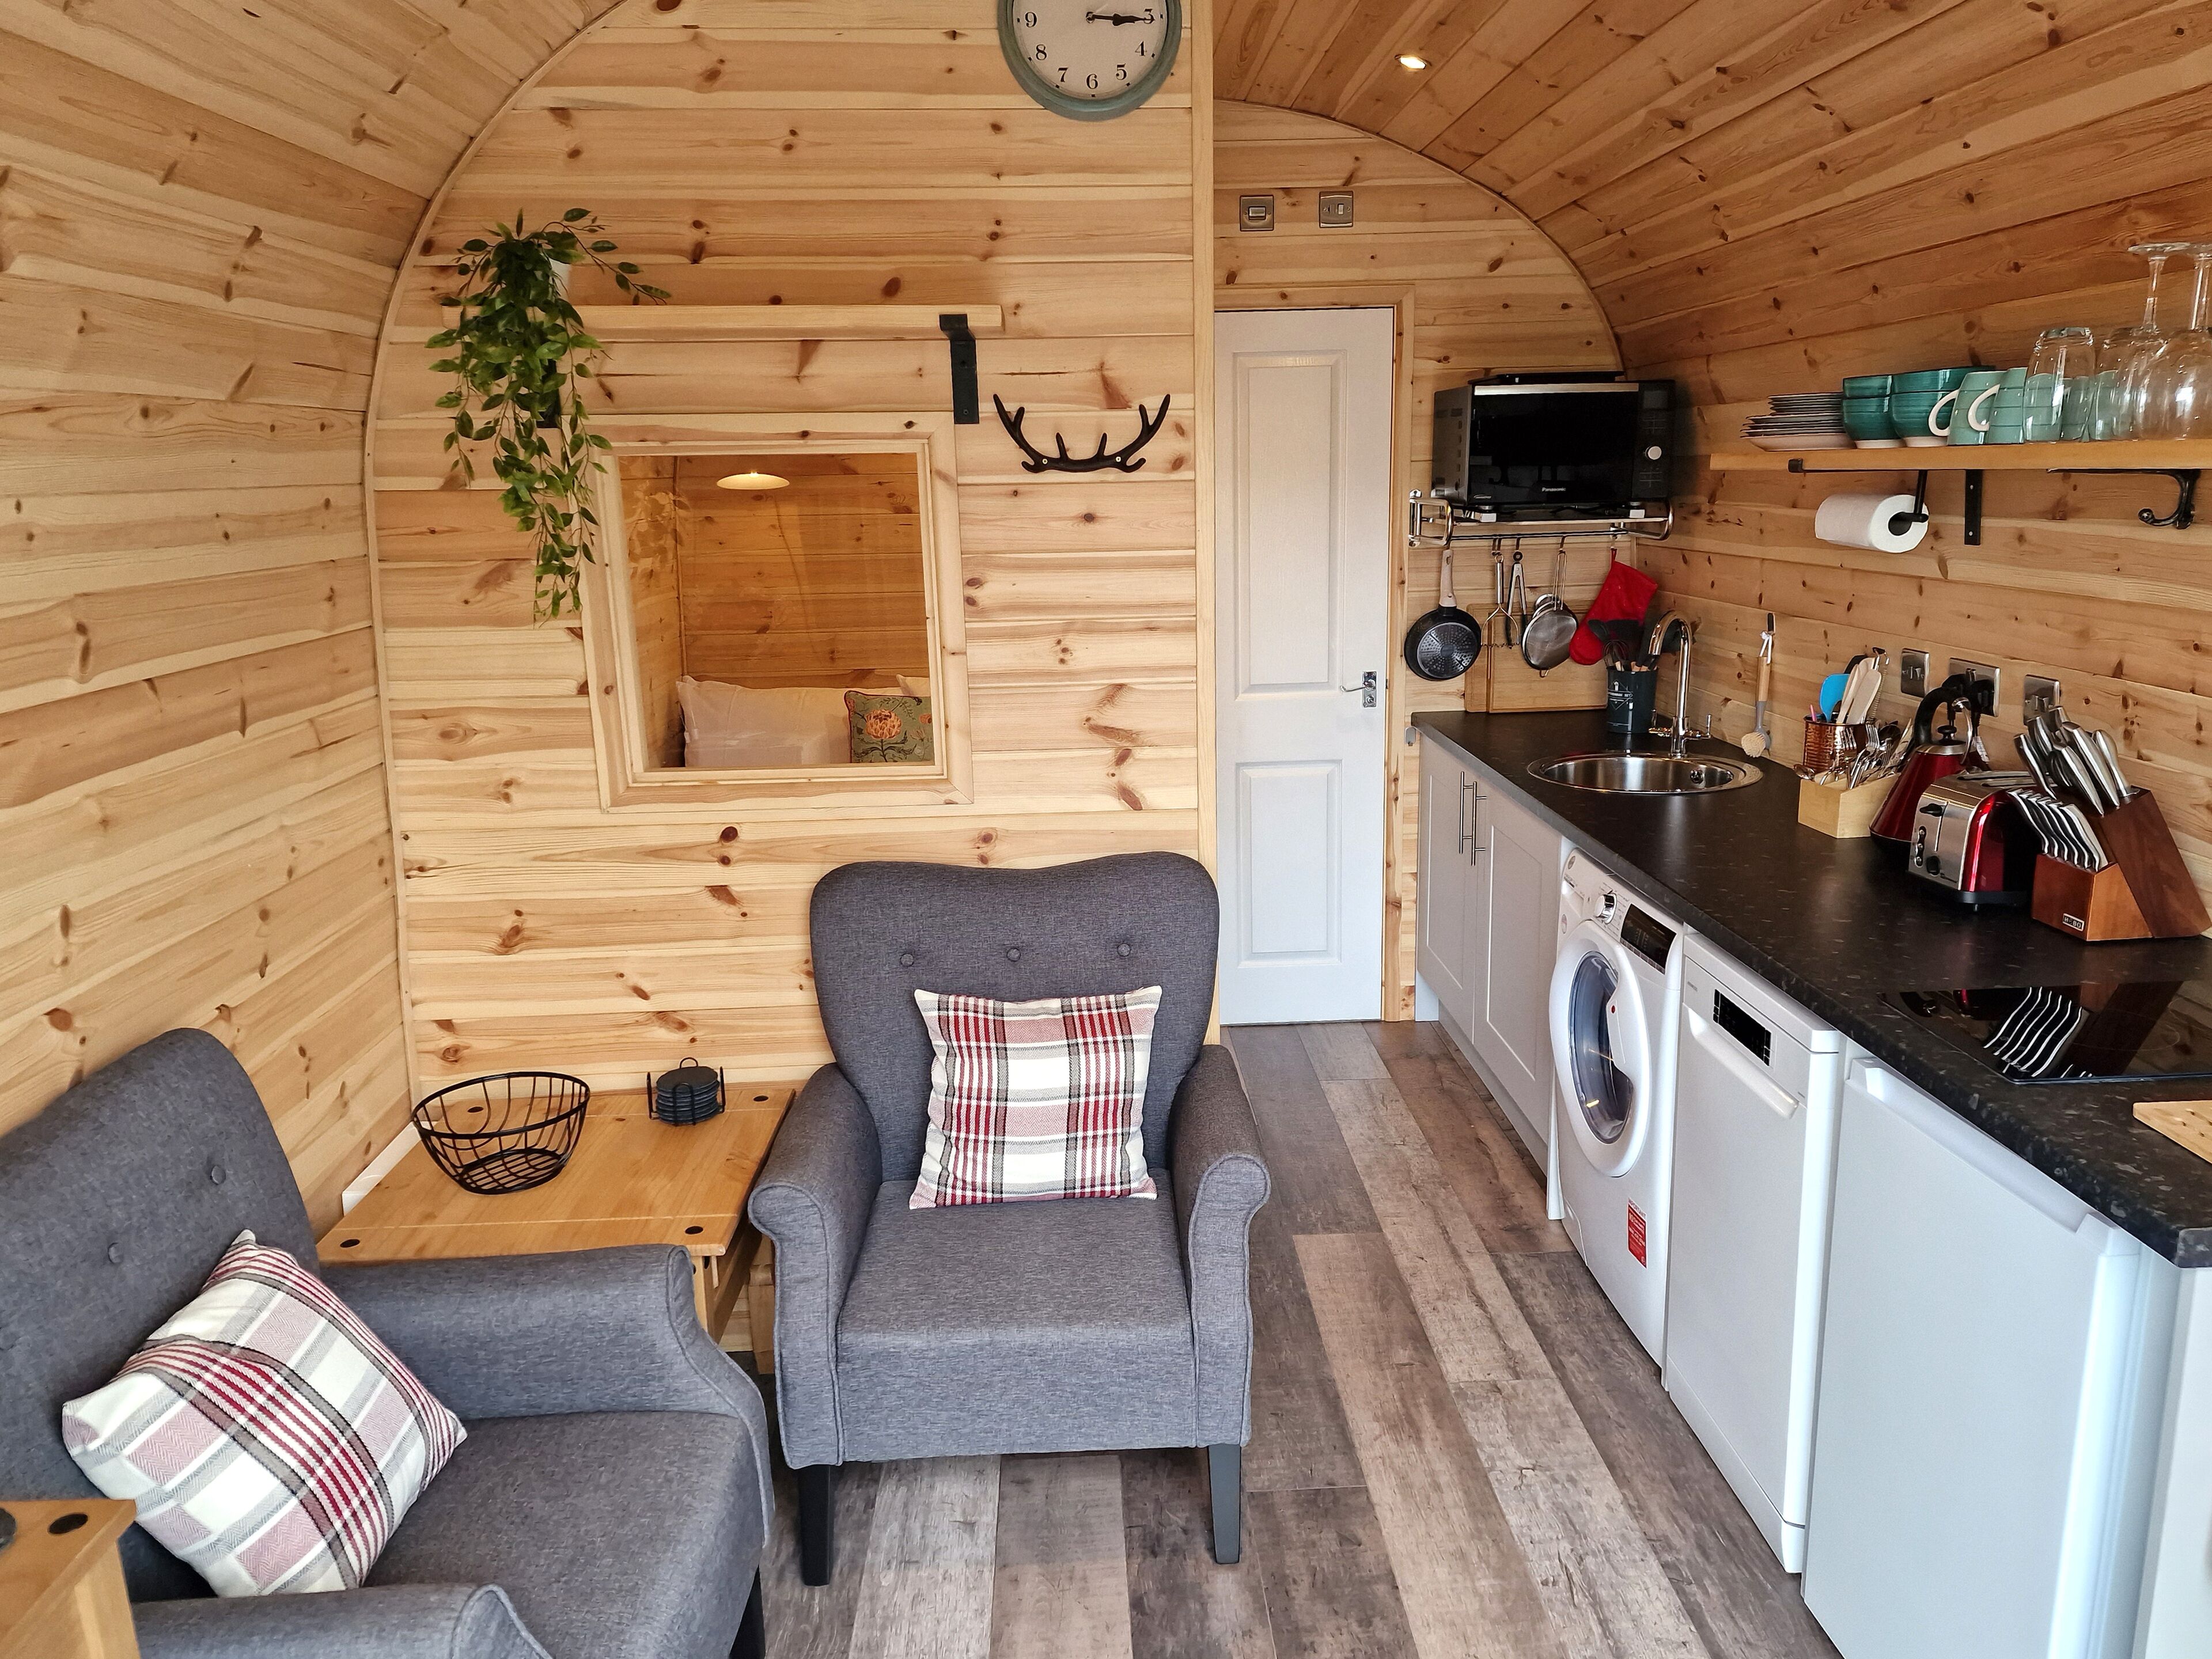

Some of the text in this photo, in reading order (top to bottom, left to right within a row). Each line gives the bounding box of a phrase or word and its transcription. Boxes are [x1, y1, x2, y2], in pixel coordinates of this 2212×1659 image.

[1025, 12, 1037, 27] 9
[1143, 9, 1154, 24] 3
[1036, 44, 1047, 60] 8
[1135, 41, 1147, 56] 4
[1058, 67, 1069, 82] 7
[1115, 63, 1127, 80] 5
[1086, 73, 1099, 89] 6
